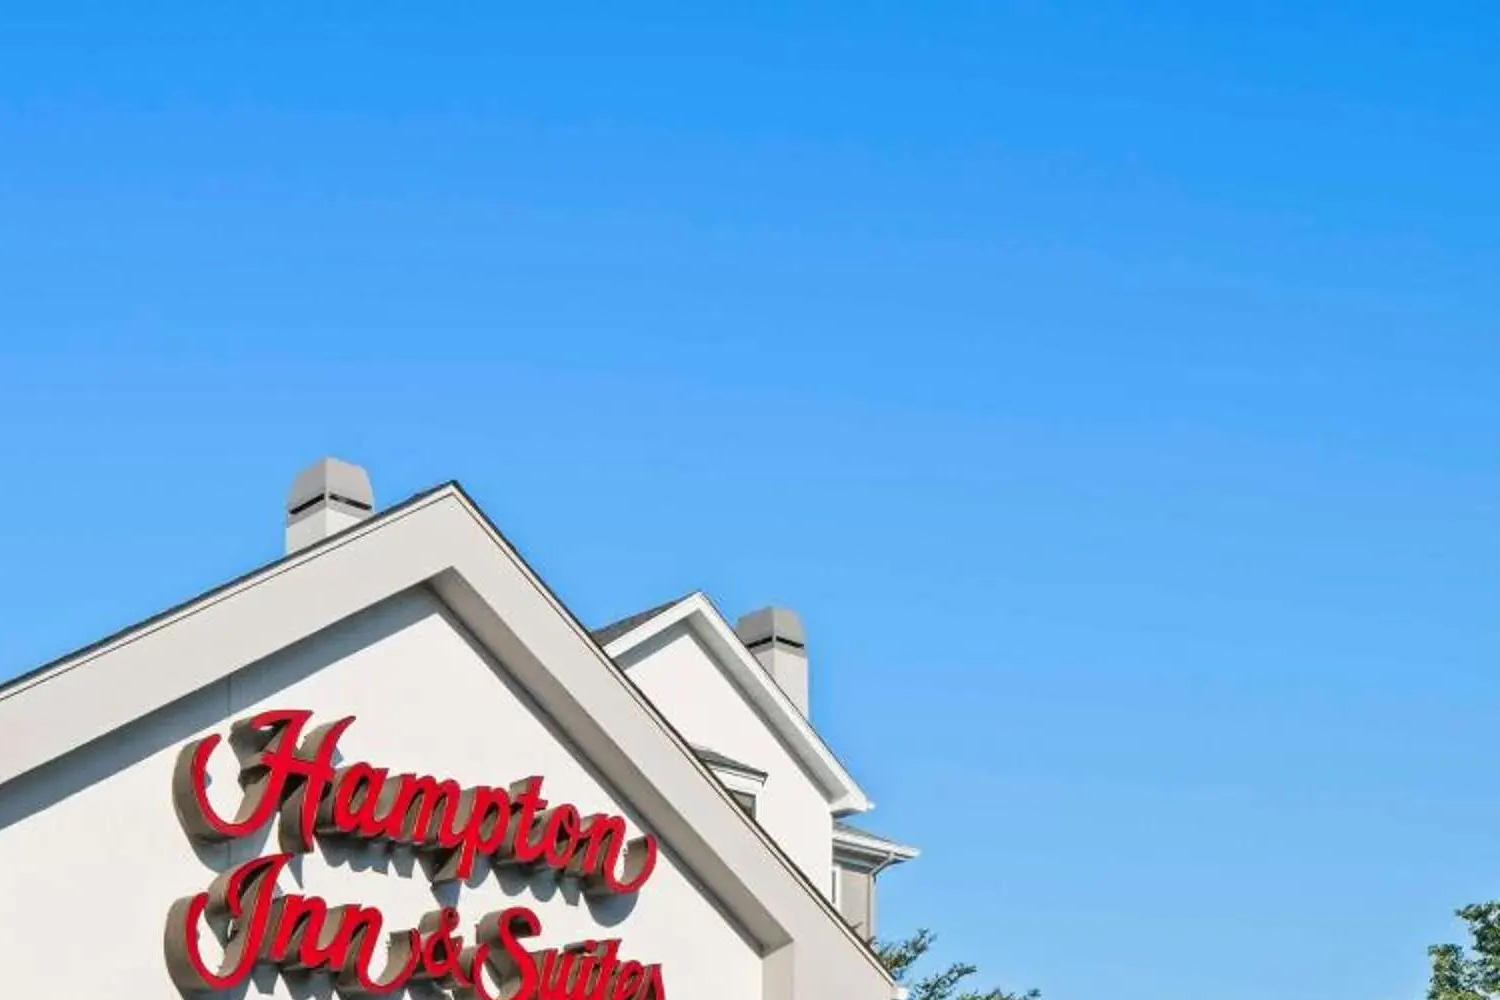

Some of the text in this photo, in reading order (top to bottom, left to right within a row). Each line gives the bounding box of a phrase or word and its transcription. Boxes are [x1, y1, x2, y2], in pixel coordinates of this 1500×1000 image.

[190, 709, 658, 894] Hampton
[185, 852, 421, 994] Inn
[423, 906, 475, 989] &
